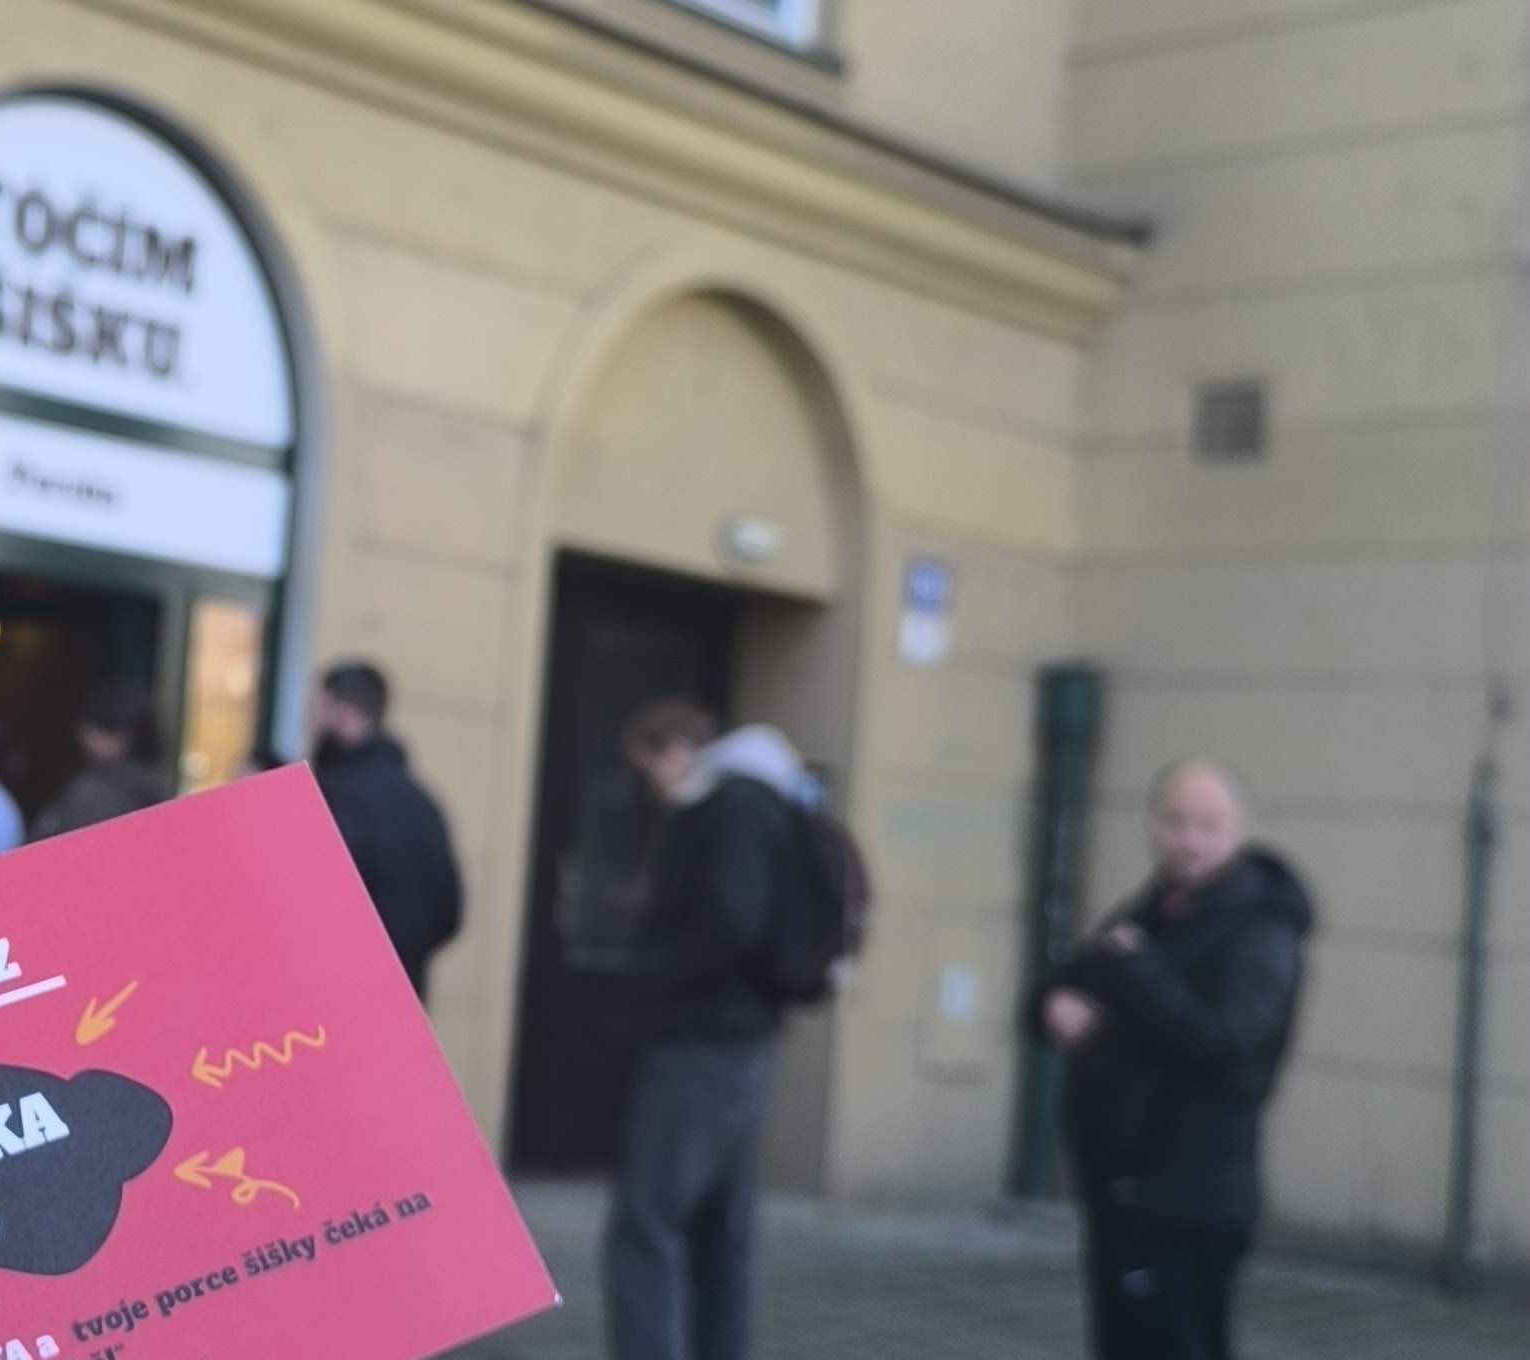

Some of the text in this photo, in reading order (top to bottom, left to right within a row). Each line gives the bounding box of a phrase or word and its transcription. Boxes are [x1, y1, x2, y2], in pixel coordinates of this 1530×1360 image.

[36, 1334, 60, 1360] a
[73, 1299, 149, 1342] tvoje
[155, 1265, 238, 1318] porce
[241, 1235, 316, 1278] šišky
[323, 1201, 389, 1245] čeká
[396, 1191, 431, 1219] na
